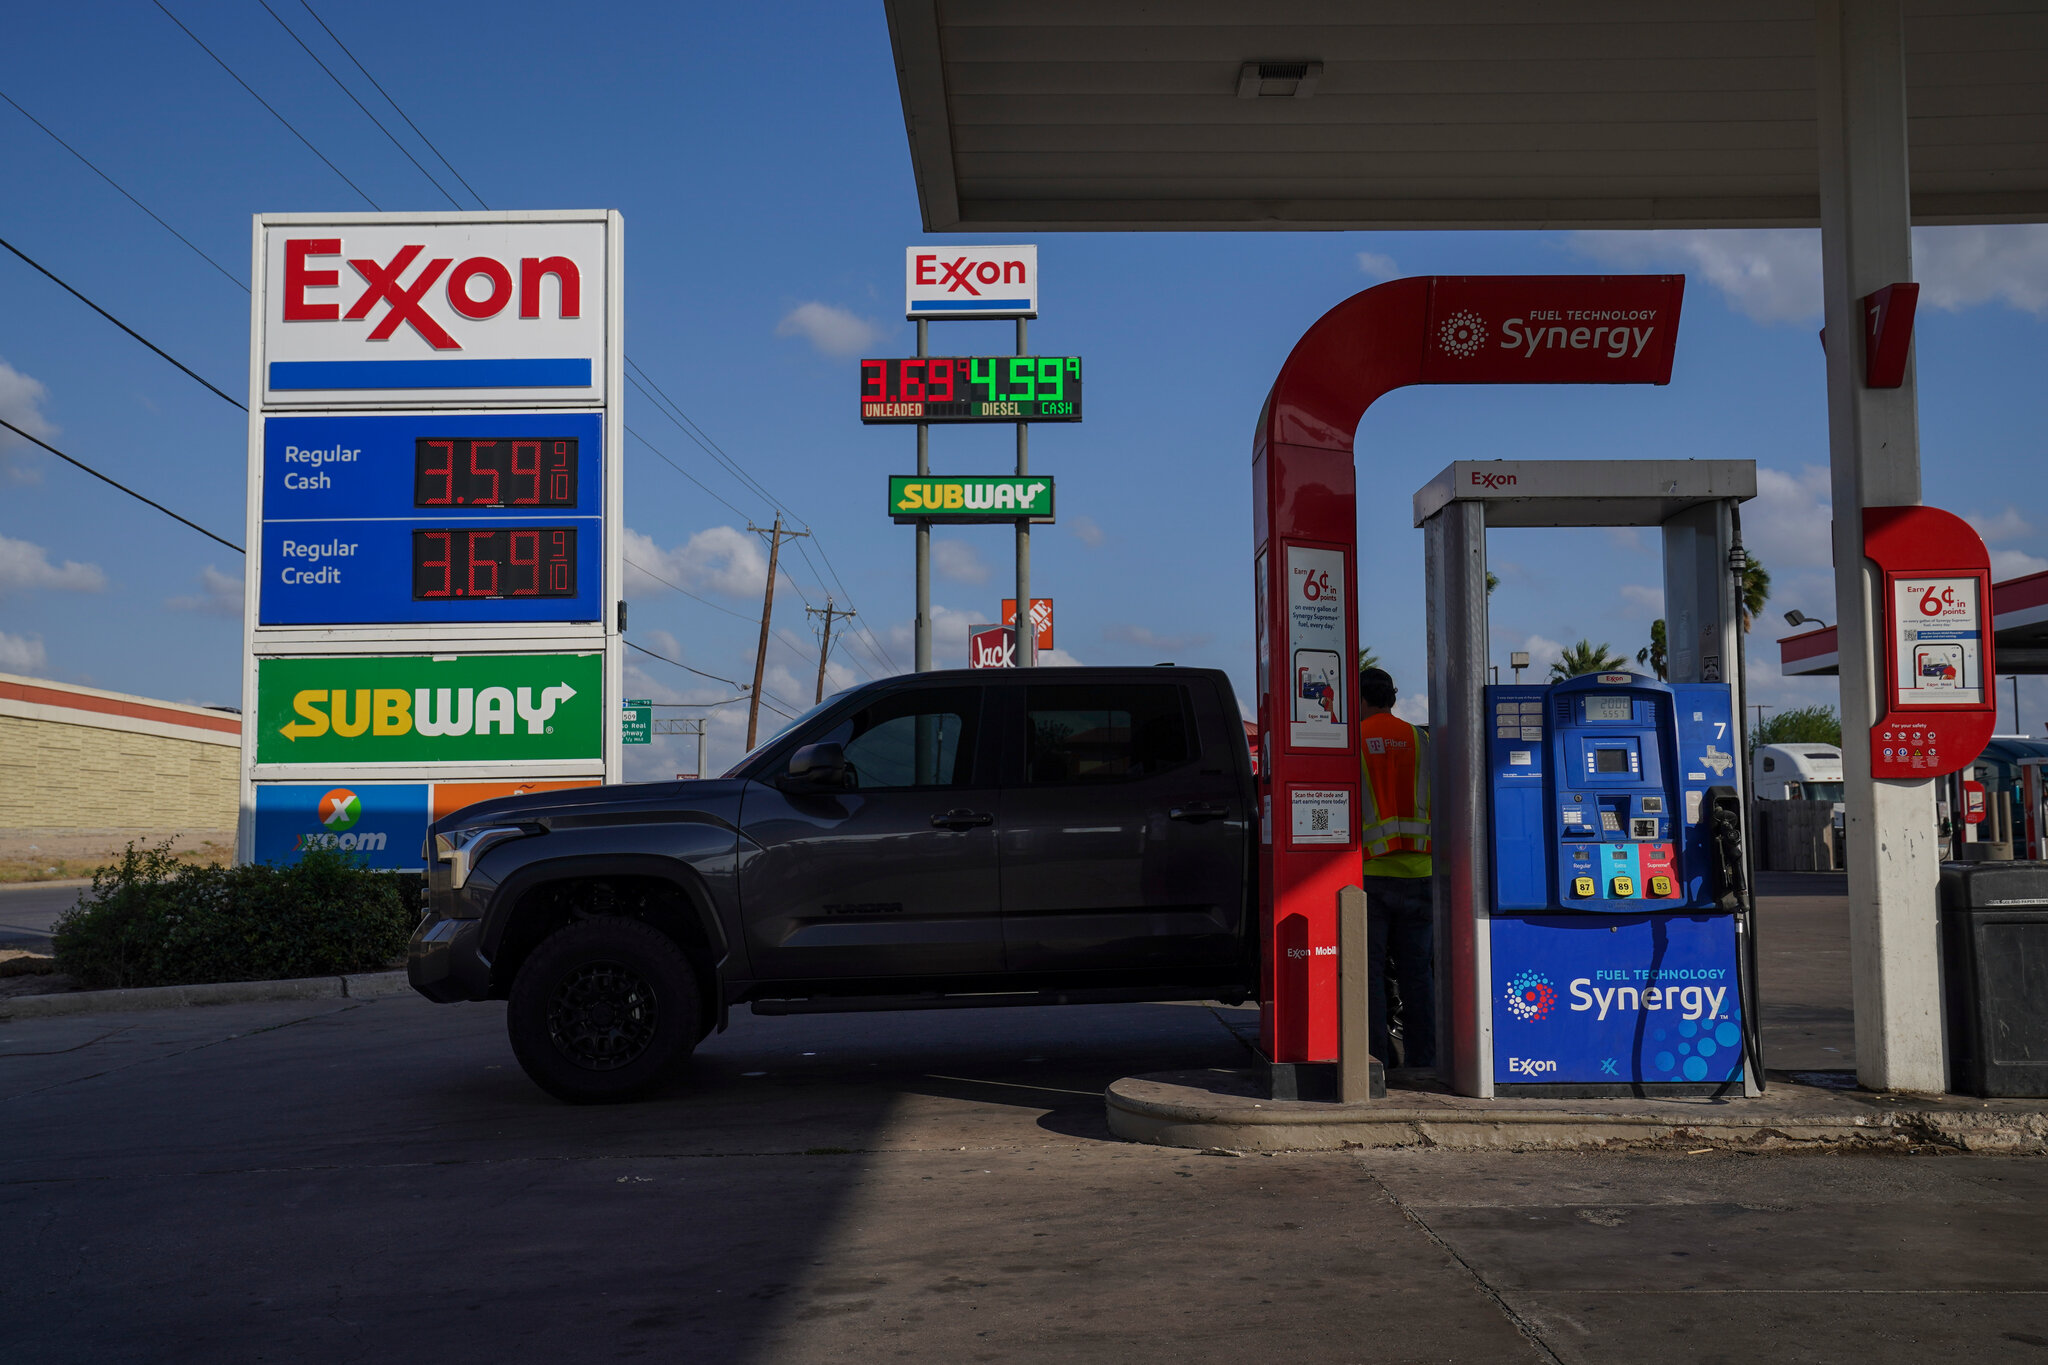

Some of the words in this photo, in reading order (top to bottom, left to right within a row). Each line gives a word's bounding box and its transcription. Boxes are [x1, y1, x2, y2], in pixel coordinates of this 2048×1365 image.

[916, 254, 1026, 296] Exxon
[283, 238, 580, 351] Exxon
[1530, 310, 1562, 321] FUEL
[1566, 310, 1657, 321] TECHNOLOGY
[1500, 318, 1654, 358] Synergy
[861, 359, 954, 402] 3.69
[971, 358, 1064, 401] 4.59
[865, 403, 922, 417] UNLEADED
[982, 402, 1021, 416] DIESEL
[1041, 402, 1073, 414] CASH
[284, 472, 331, 490] Cash
[285, 445, 361, 466] Regular
[425, 441, 541, 504] 3.59
[1471, 472, 1517, 490] Exxon
[897, 482, 1046, 511] SUBWAY
[282, 539, 358, 560] Regular
[423, 532, 539, 597] 3.69
[281, 566, 341, 585] Credit
[1320, 594, 1337, 602] points
[1330, 585, 1337, 594] in
[1942, 608, 1966, 616] points
[1957, 599, 1966, 607] in
[1293, 612, 1313, 621] Synergy
[974, 633, 1016, 668] Jack
[279, 681, 577, 742] SUBWAY
[1713, 722, 1727, 739] 7
[1384, 738, 1407, 747] Fiber
[1287, 948, 1311, 960] Exxon
[1596, 969, 1626, 980] FUEL
[1633, 968, 1726, 980] TECHNOLOGY
[1570, 978, 1727, 1021] Synergy
[1509, 1057, 1557, 1077] Exxon
